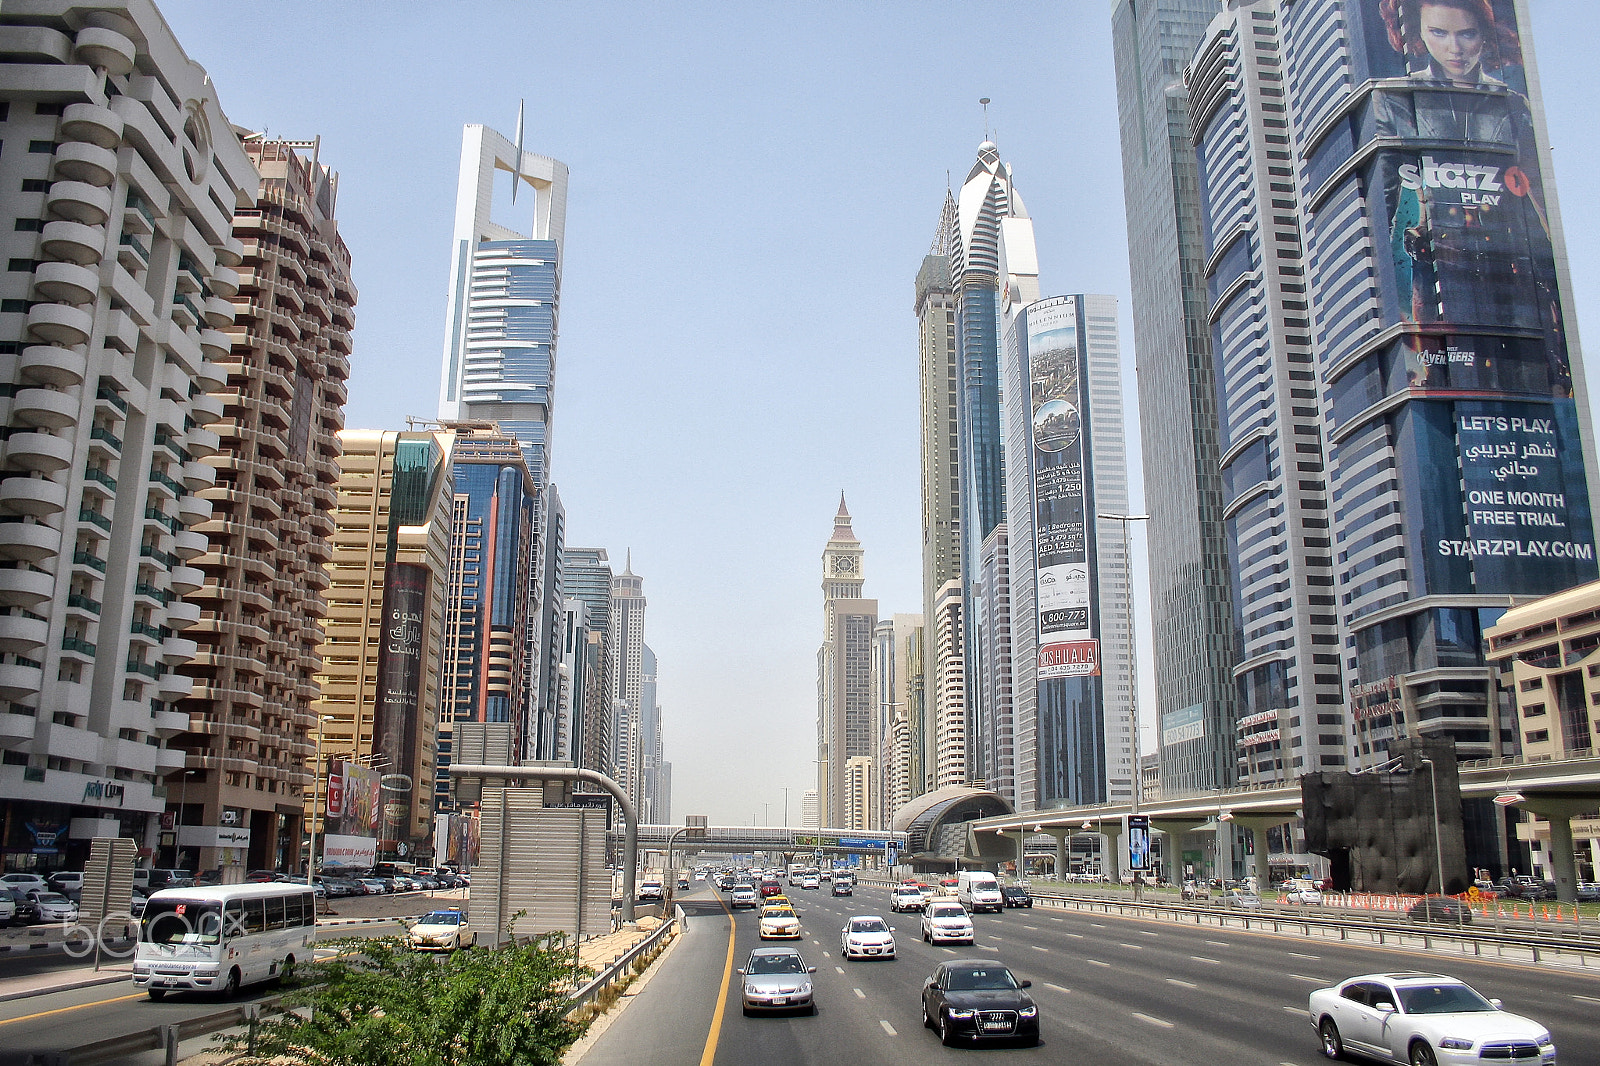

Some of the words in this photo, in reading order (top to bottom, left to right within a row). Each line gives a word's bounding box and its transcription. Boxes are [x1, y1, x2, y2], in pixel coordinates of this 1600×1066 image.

[1461, 192, 1501, 206] PLAY
[1460, 415, 1508, 431] LET'S
[1511, 417, 1554, 434] PLAY.
[1465, 441, 1517, 462] تجريبي
[1520, 441, 1557, 459] شهر
[1058, 483, 1082, 493] 1,250
[1468, 490, 1505, 505] ONE
[1507, 491, 1565, 508] MONTH
[1472, 510, 1516, 525] FREE
[1517, 511, 1566, 527] TRIAL.
[1039, 544, 1053, 553] AED
[1054, 541, 1075, 550] 1,250
[1438, 539, 1593, 560] STARZPLAY.COM
[1048, 610, 1086, 623] 800-773
